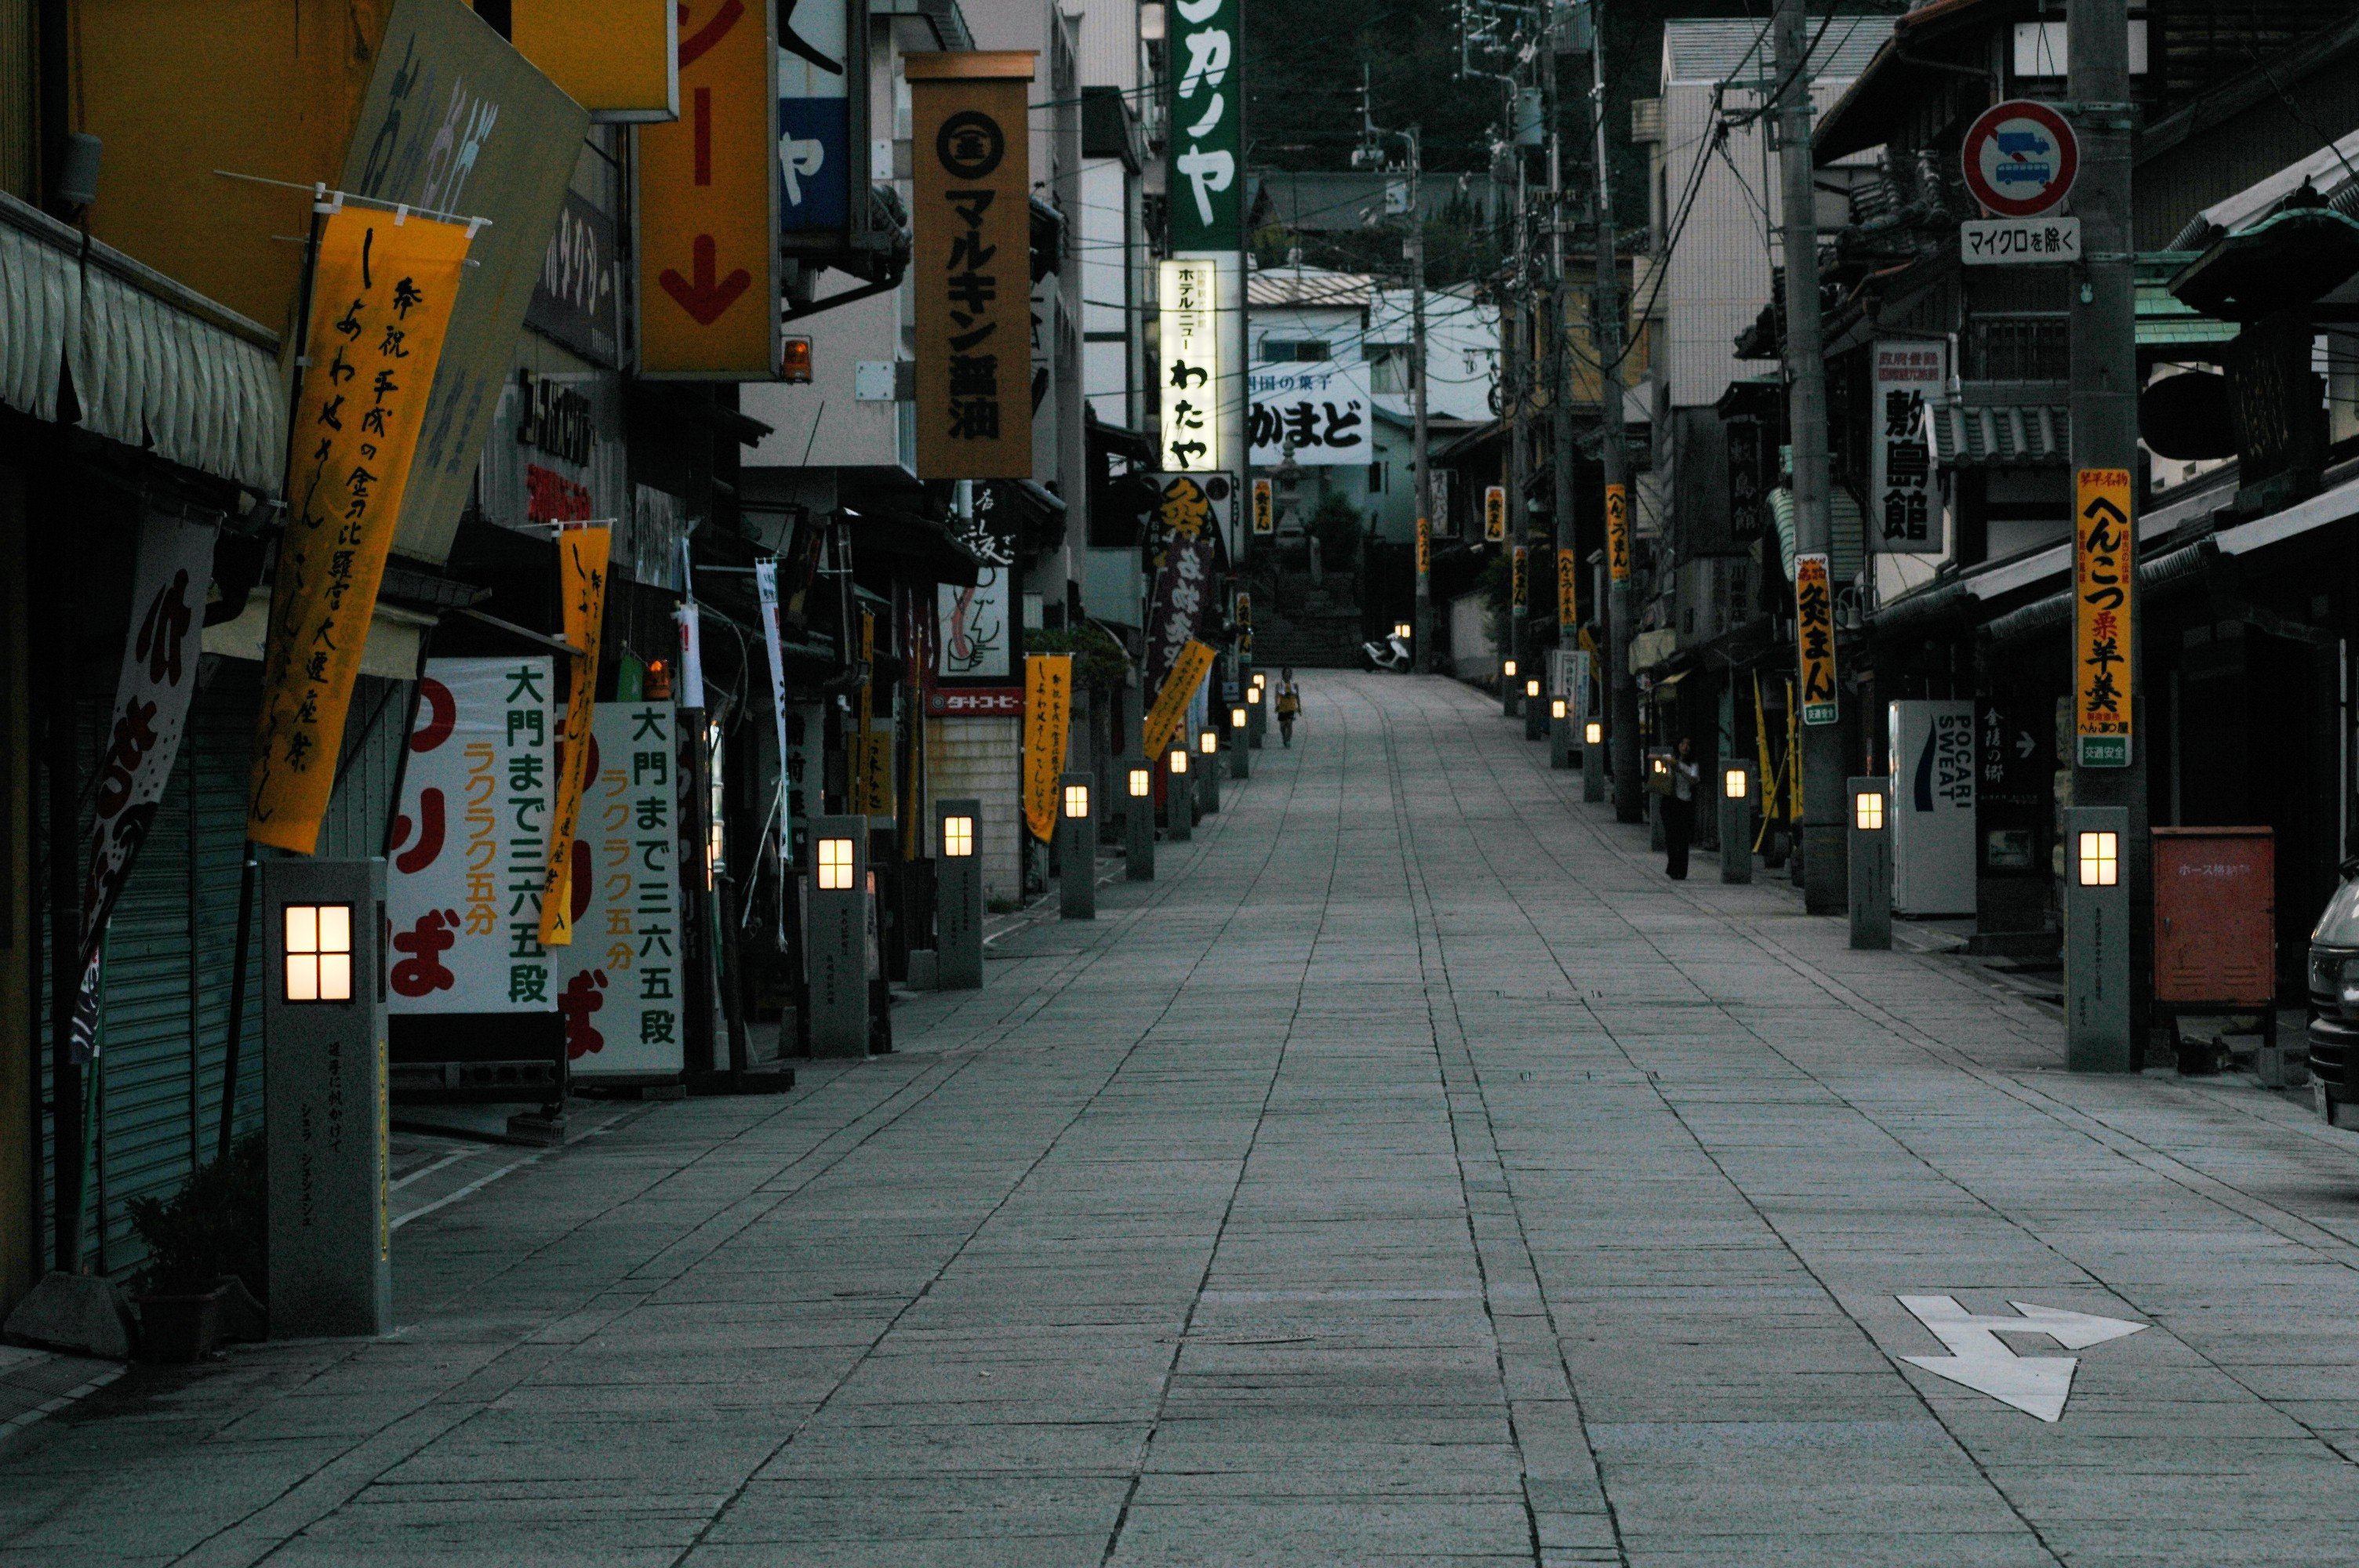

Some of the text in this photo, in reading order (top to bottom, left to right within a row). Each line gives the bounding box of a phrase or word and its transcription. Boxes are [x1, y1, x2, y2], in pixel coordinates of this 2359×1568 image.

[1969, 227, 2073, 254] マイクロを除く
[1179, 269, 1194, 350] ホテルニュー
[1170, 359, 1208, 469] わたや
[1249, 400, 1361, 448] かまど
[1884, 389, 1929, 540] 敷島館
[1799, 583, 1836, 701] 灸まん
[1939, 716, 1954, 800] SWEAT
[1955, 715, 1972, 808] POCARI
[2085, 746, 2125, 759] 交通安全
[463, 742, 498, 935] ラクラク五分
[505, 666, 548, 1003] 大門まで三六五段
[602, 769, 633, 970] ラクラク五分
[632, 707, 674, 1044] 大門まで三六五段
